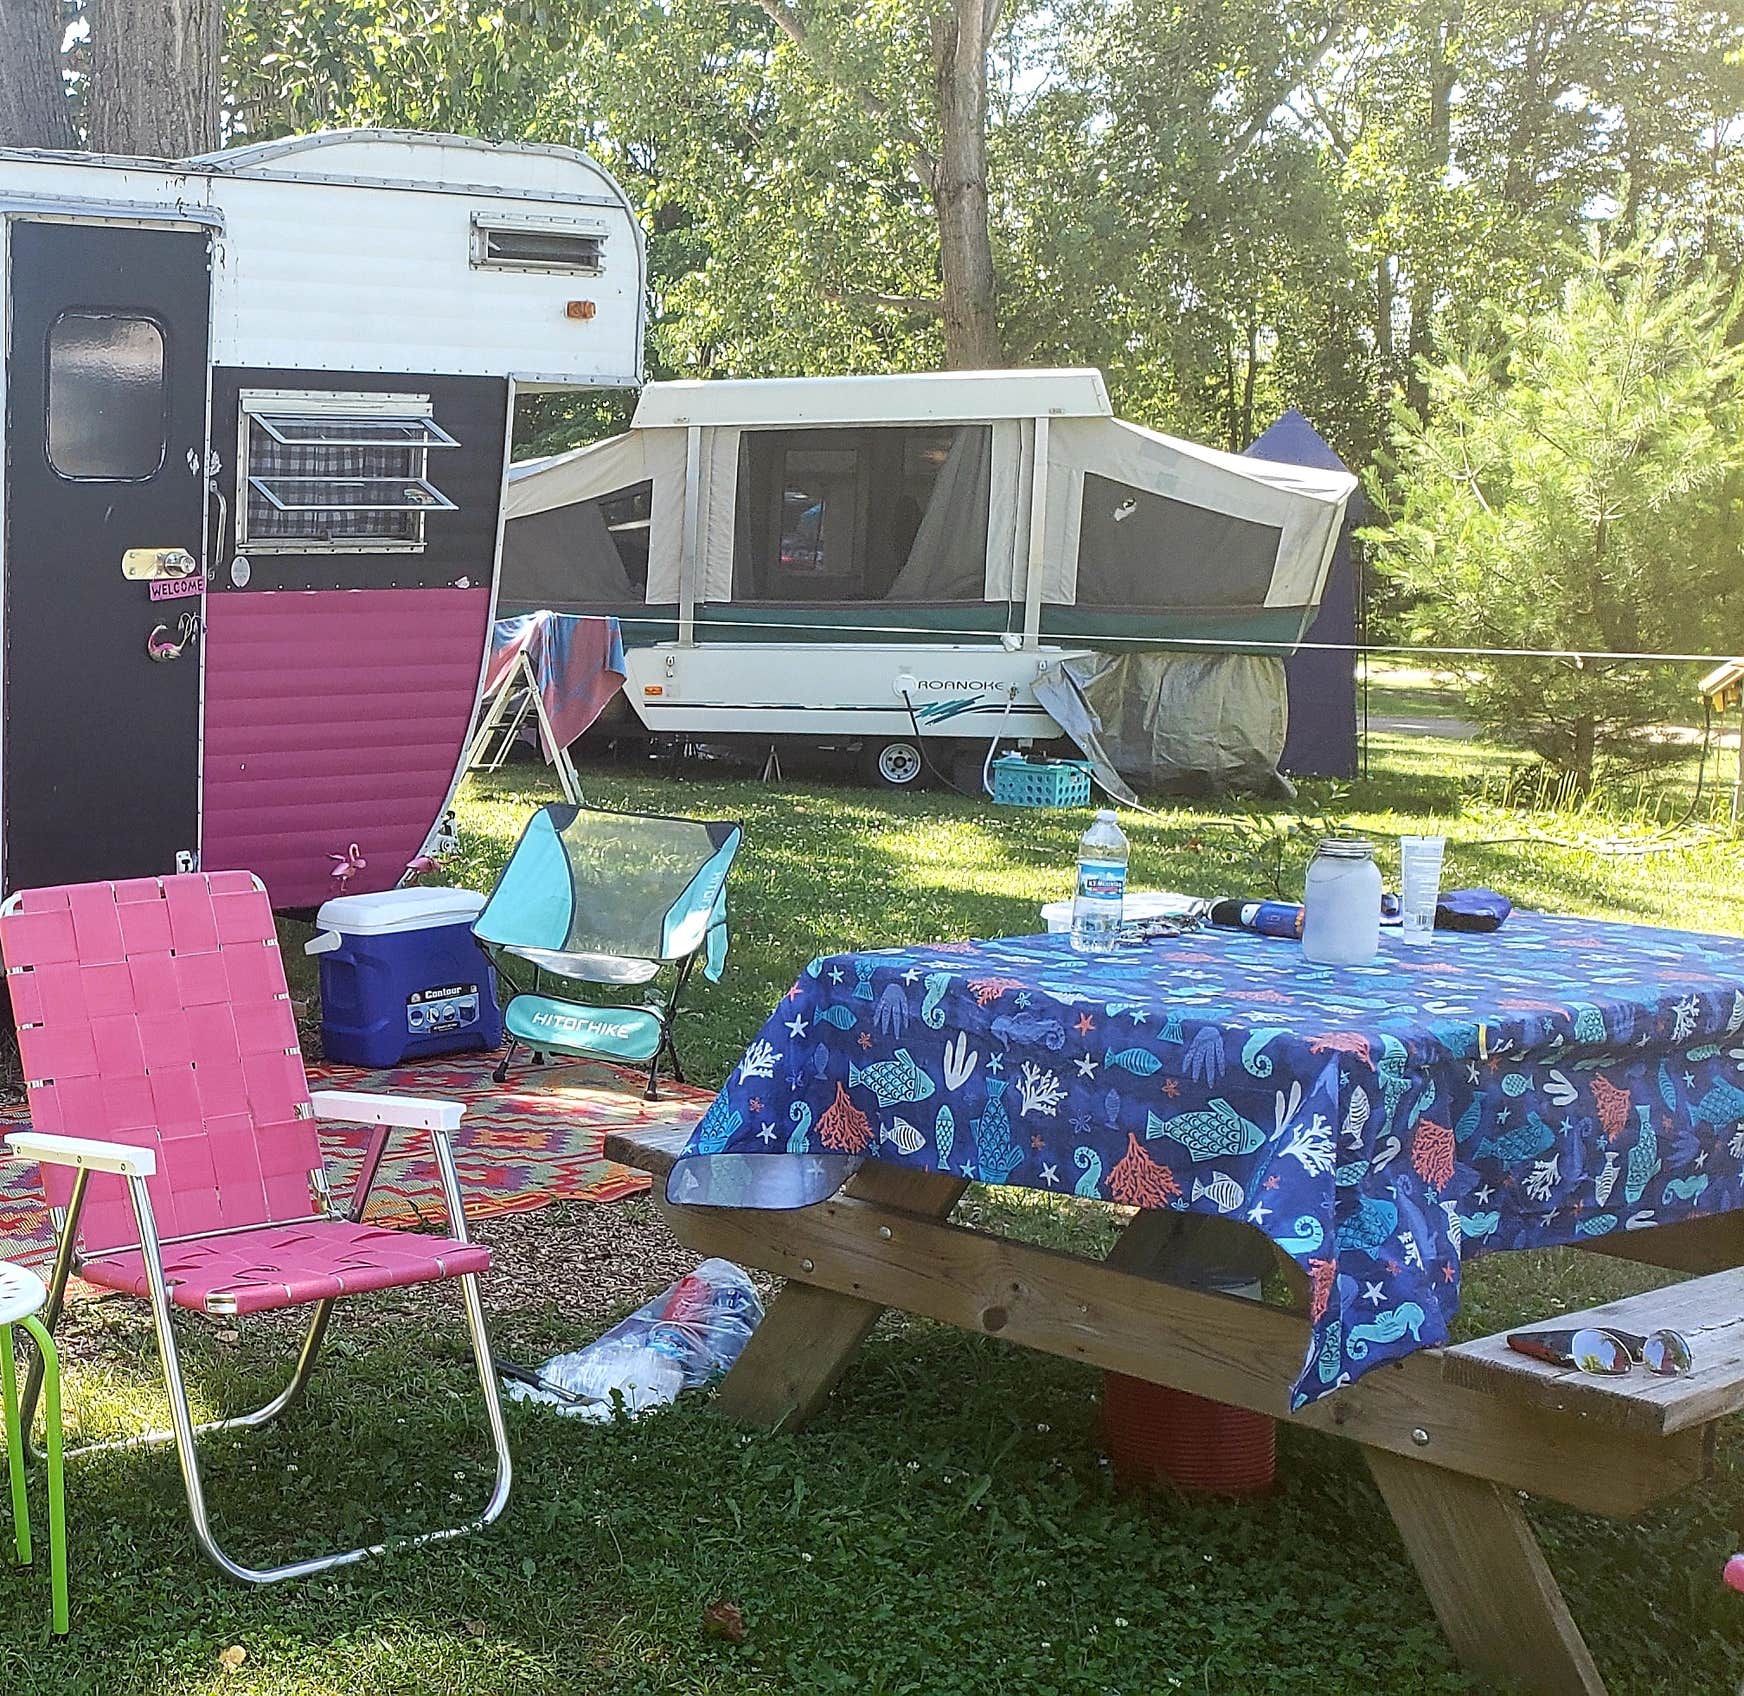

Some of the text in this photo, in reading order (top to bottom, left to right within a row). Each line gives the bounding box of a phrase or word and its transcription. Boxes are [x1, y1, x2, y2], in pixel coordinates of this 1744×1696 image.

[151, 579, 204, 596] WELCOME
[917, 680, 1005, 691] ROANOKE
[424, 986, 463, 999] Contour
